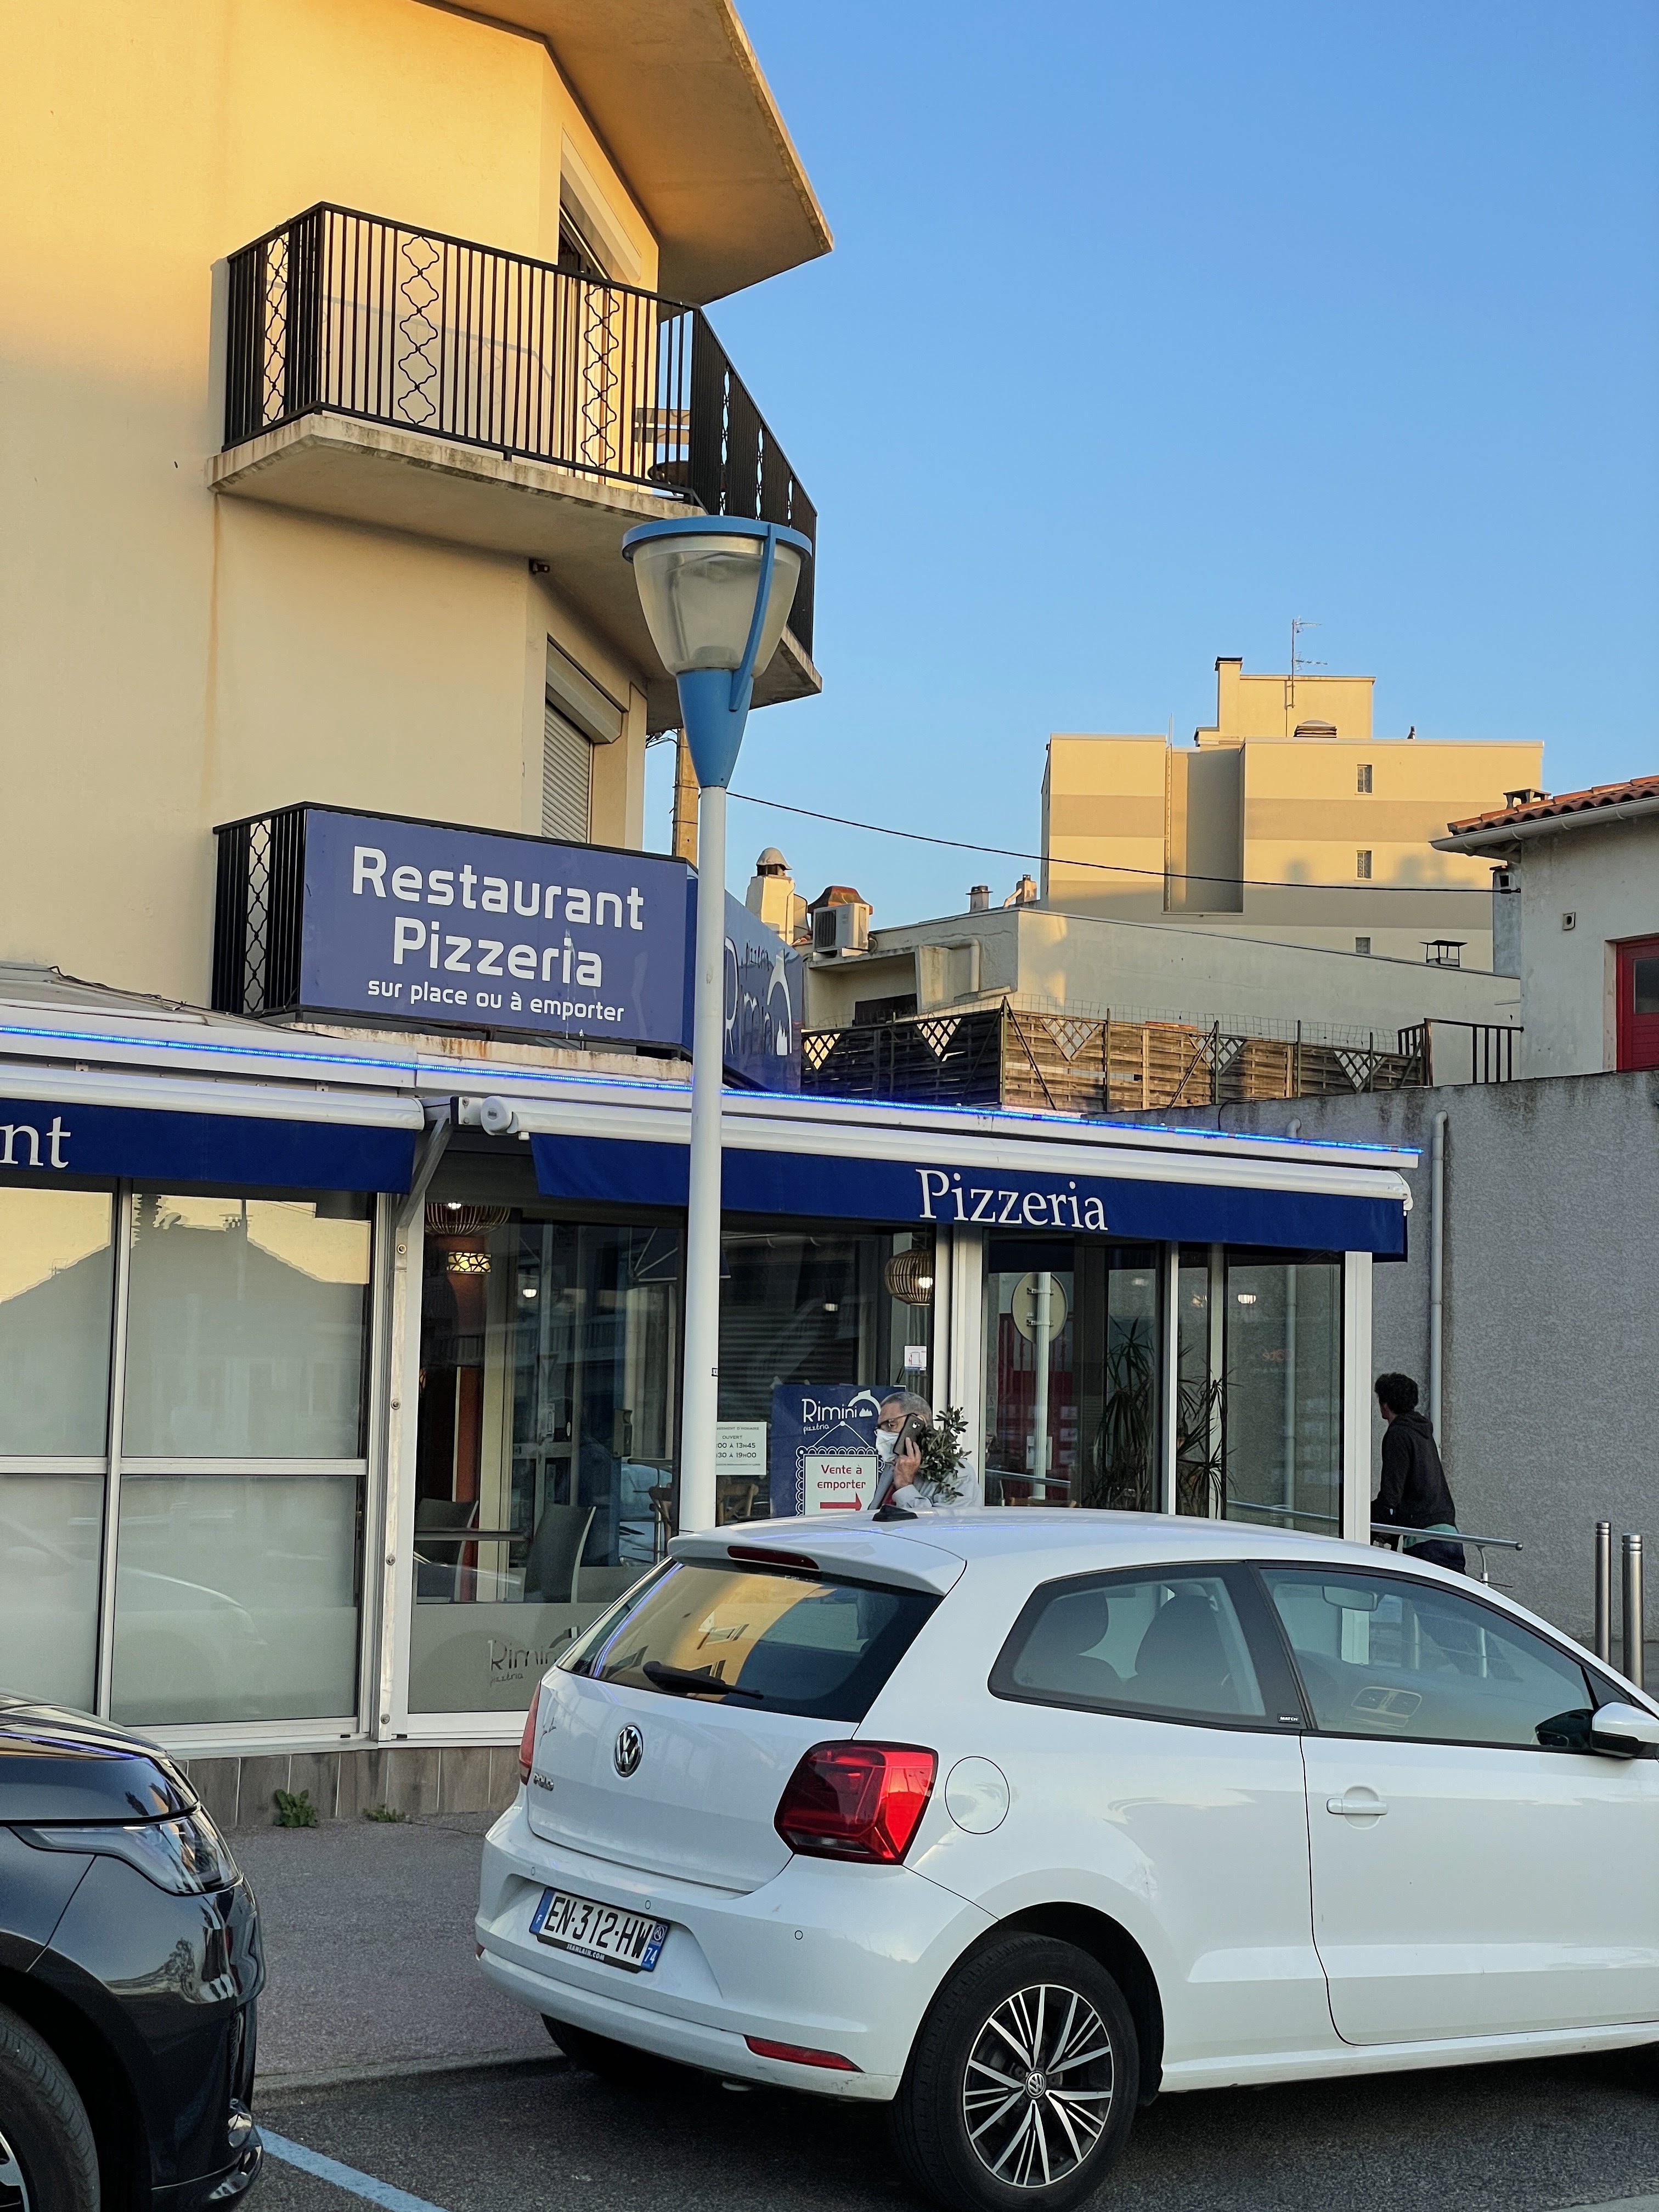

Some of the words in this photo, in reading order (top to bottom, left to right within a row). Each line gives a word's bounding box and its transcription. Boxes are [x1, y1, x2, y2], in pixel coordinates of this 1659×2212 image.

[352, 845, 644, 931] Restaurant
[392, 915, 602, 988] Pizzeria
[368, 980, 403, 998] sur
[410, 981, 468, 1005] place
[476, 991, 503, 1009] ou
[510, 991, 522, 1012] à
[529, 997, 625, 1022] emporter
[915, 1169, 1108, 1231] Pizzeria
[801, 1398, 857, 1423] Rimini
[817, 1479, 866, 1491] emporter
[821, 1464, 852, 1474] Vente
[856, 1464, 862, 1475] à
[535, 1914, 543, 1924] F
[544, 1895, 653, 1959] EN-312-HW
[644, 1947, 658, 1965] 74
